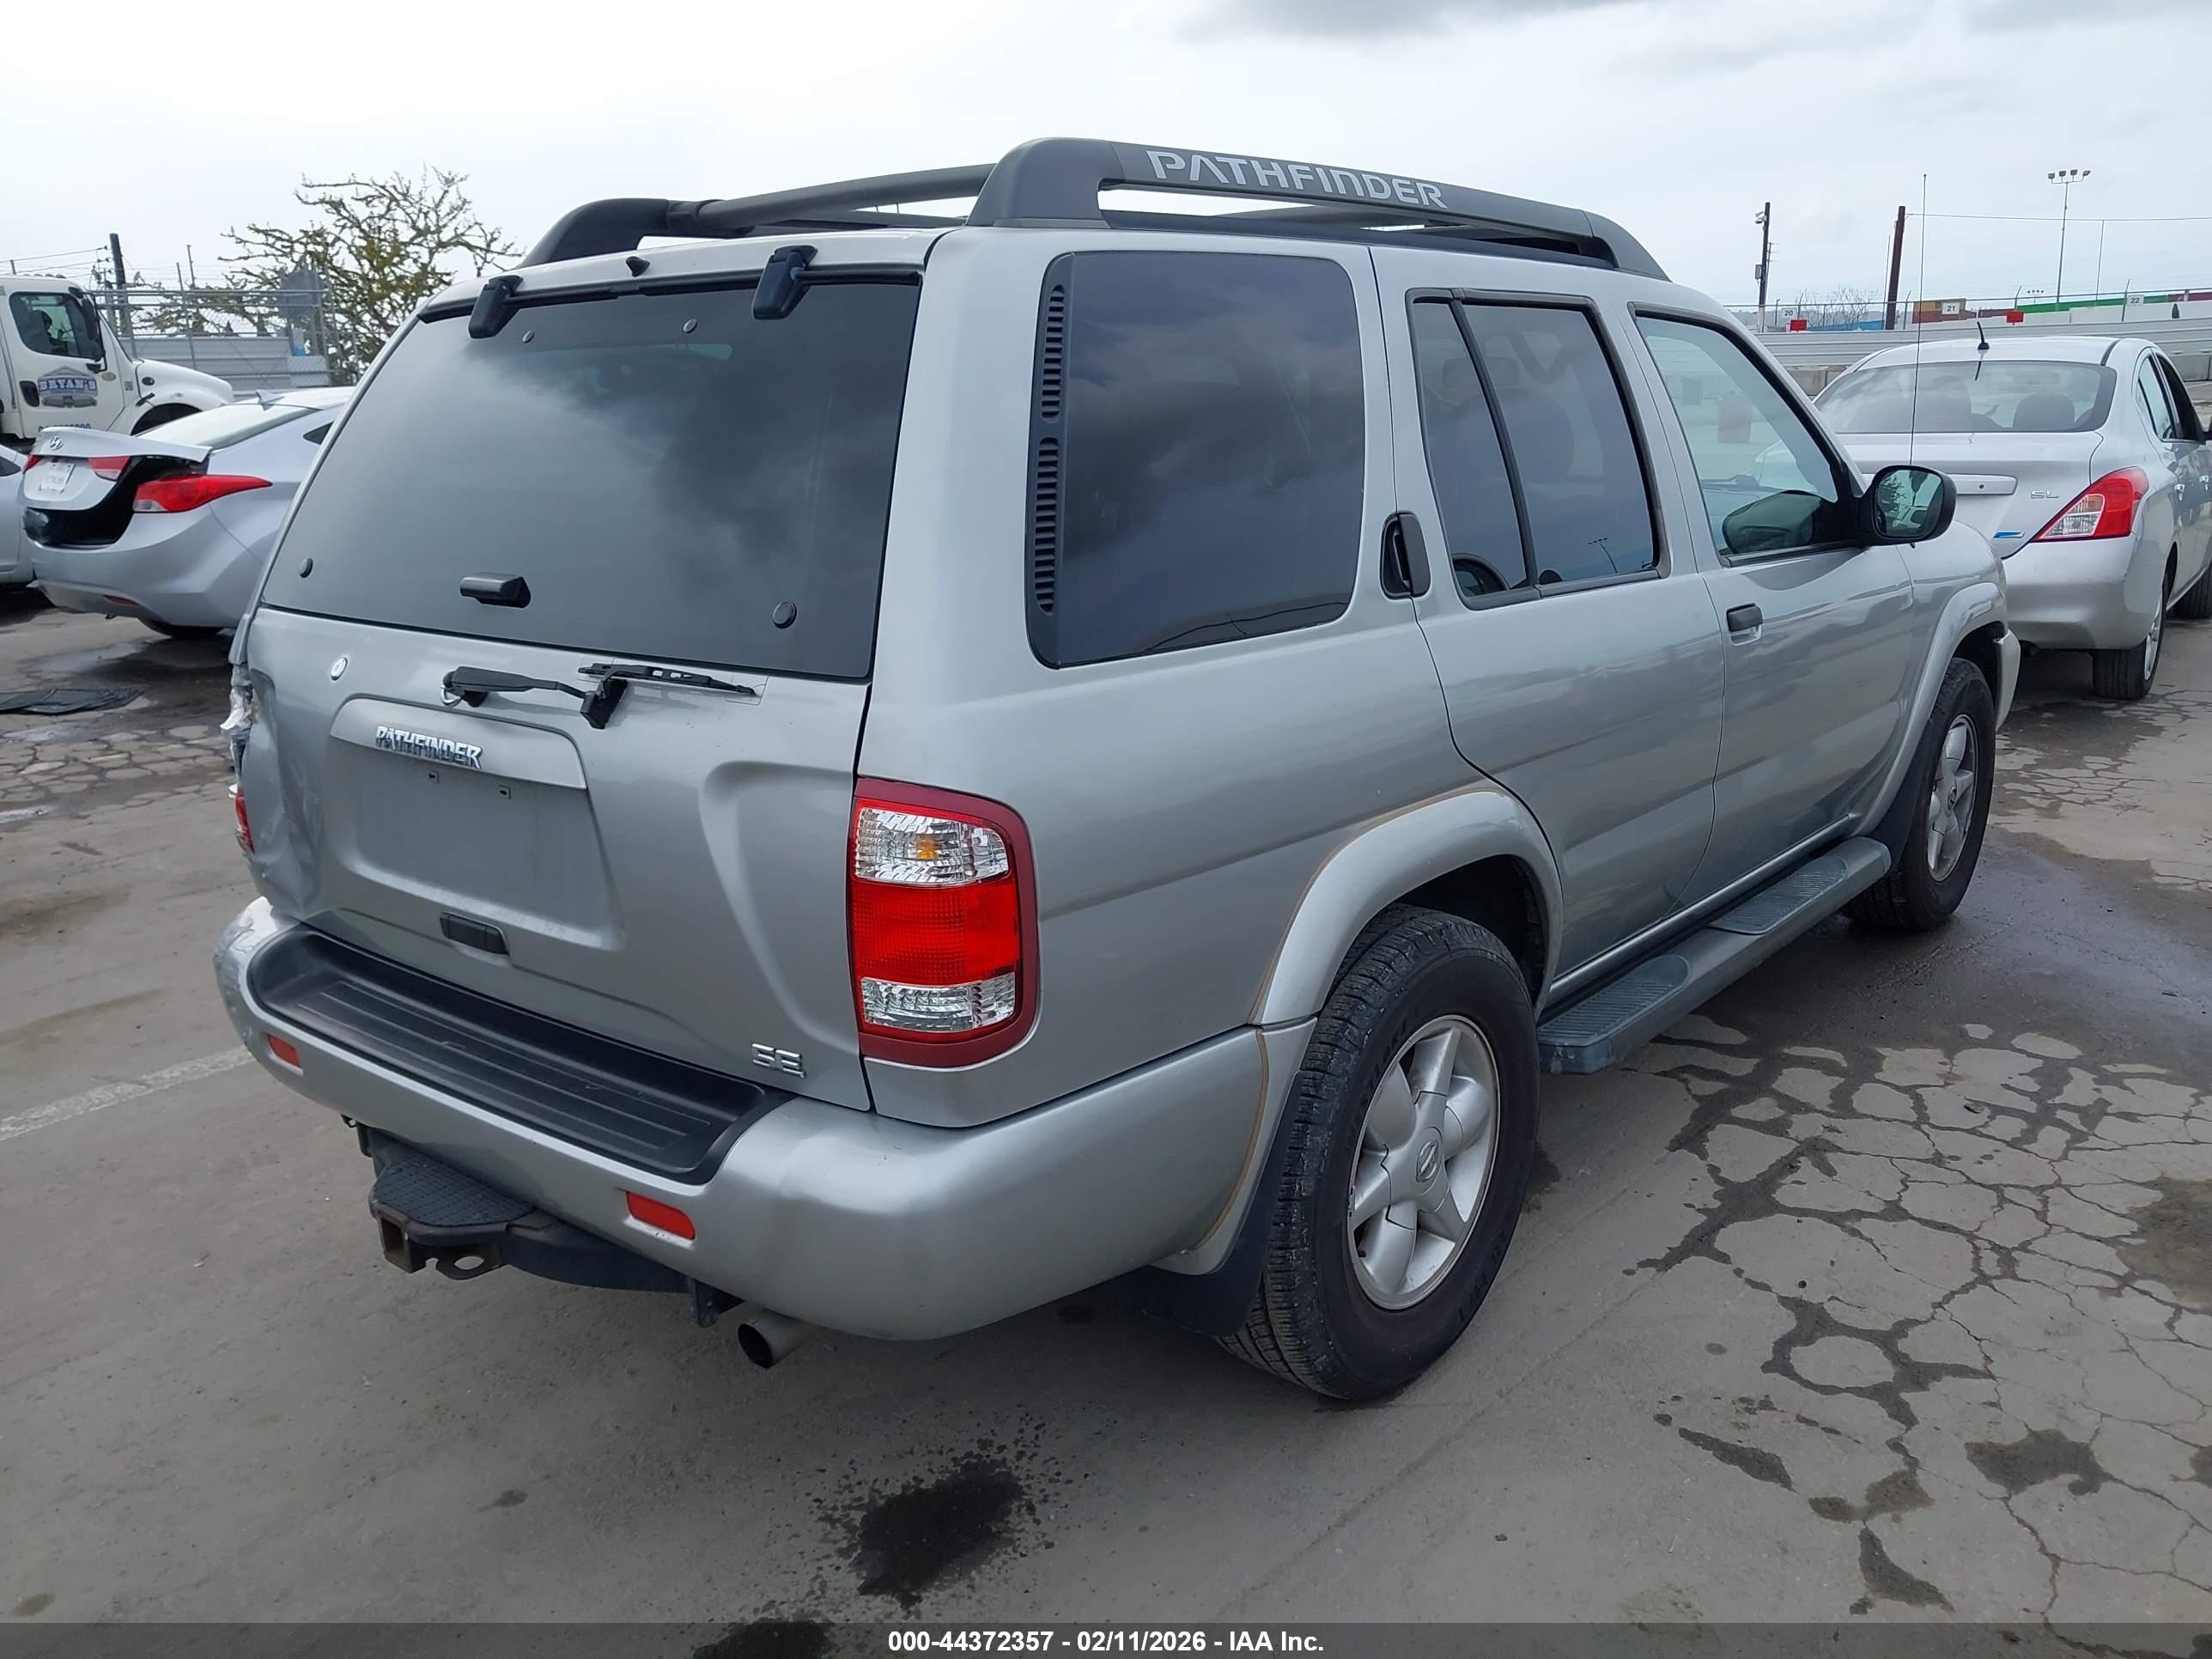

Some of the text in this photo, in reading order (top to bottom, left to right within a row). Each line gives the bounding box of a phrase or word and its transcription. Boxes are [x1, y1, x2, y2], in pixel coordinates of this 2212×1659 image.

[1146, 150, 1449, 209] PATHFINDER
[39, 379, 97, 392] BRYAN'S
[2030, 490, 2060, 499] SL
[375, 726, 483, 769] PATHFINDER
[751, 1042, 805, 1079] SE
